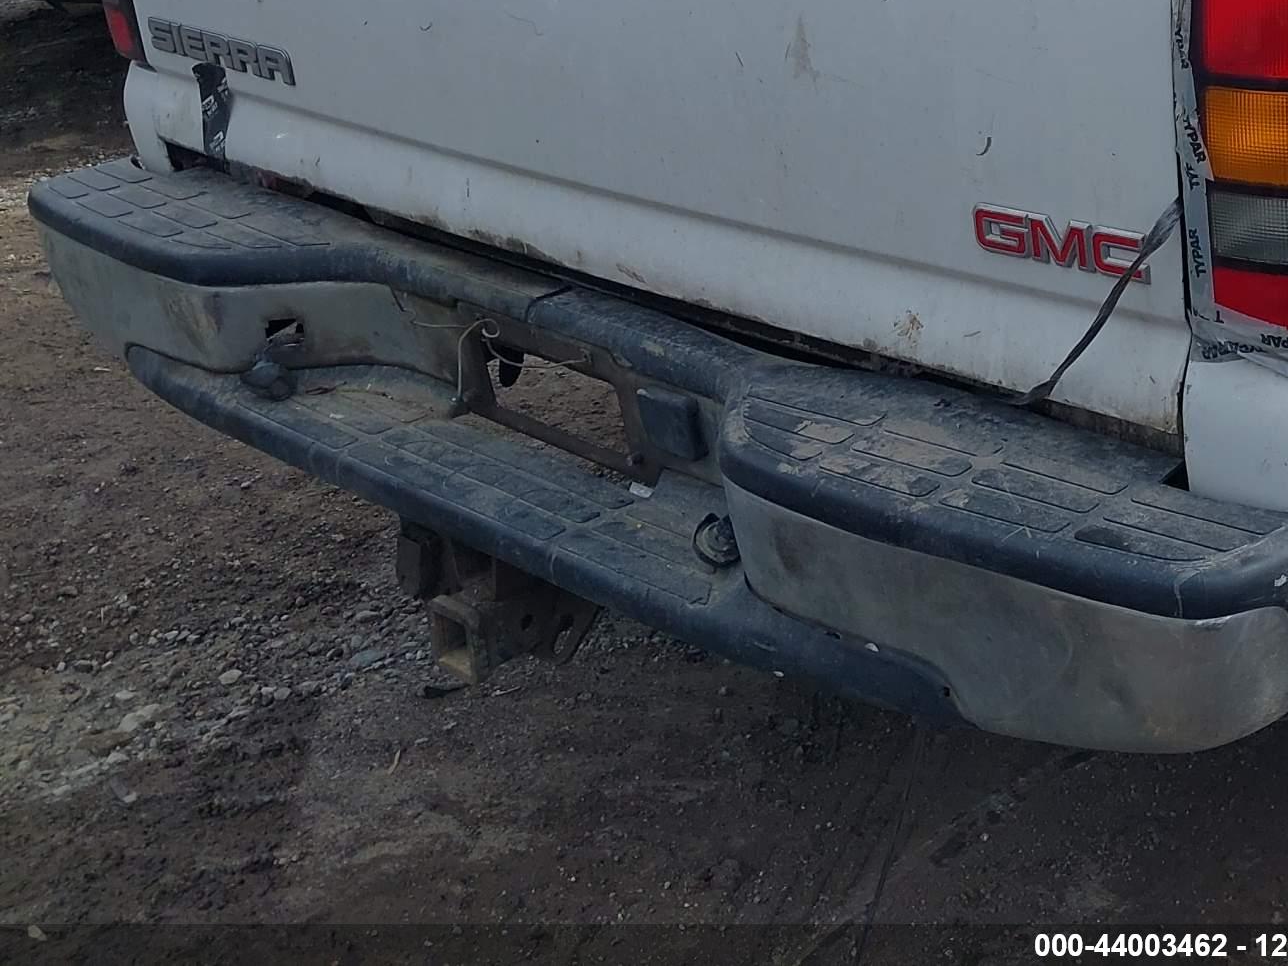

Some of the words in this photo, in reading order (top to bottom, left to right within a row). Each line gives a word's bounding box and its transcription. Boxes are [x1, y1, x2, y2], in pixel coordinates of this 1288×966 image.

[148, 17, 296, 86] SIERRA
[1182, 117, 1206, 164] TYPAR
[973, 202, 1152, 285] GMC
[1188, 228, 1206, 278] TYPAR
